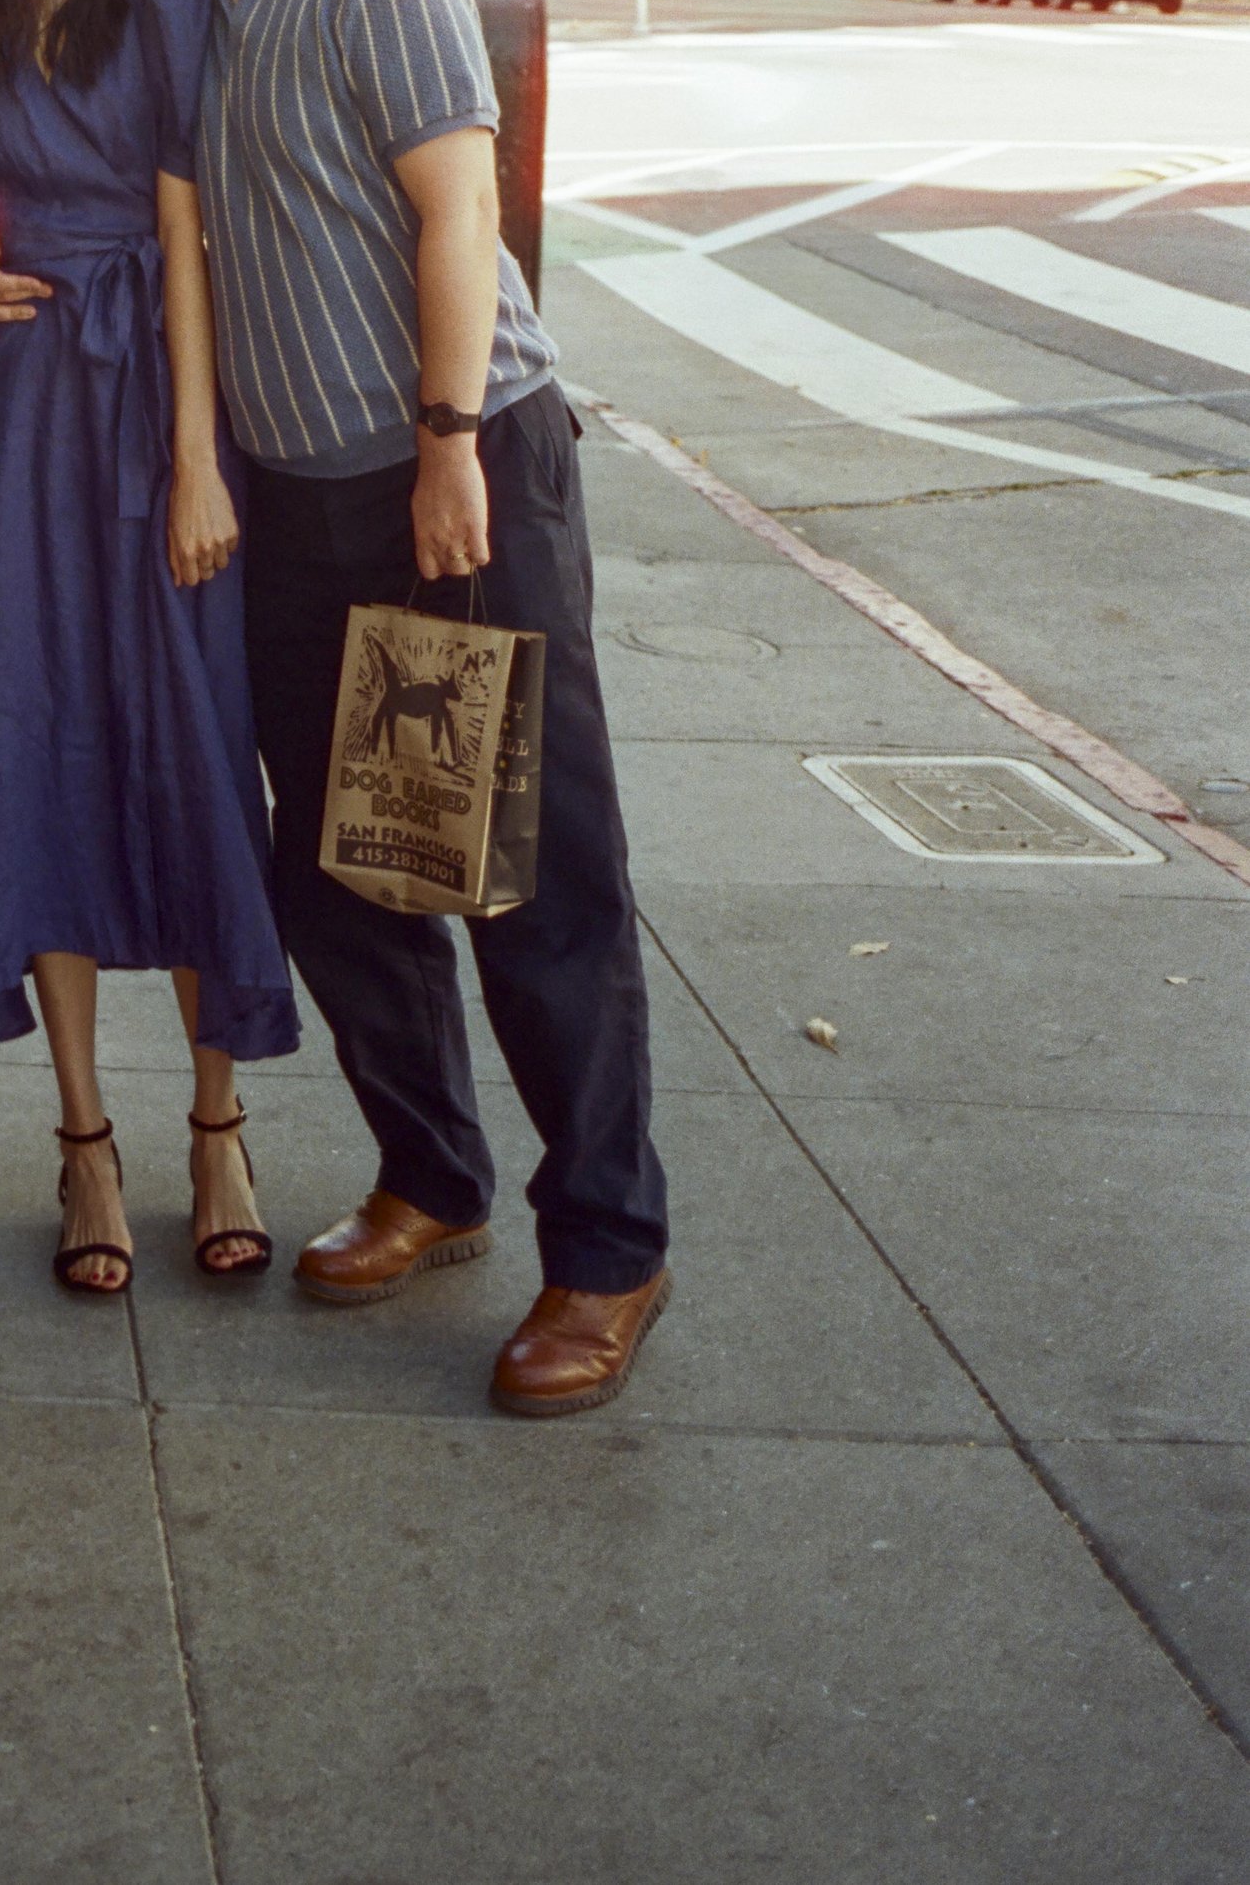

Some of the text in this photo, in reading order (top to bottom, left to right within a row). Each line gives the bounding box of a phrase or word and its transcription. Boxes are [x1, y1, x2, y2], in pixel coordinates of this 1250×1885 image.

[340, 767, 472, 815] DOG EARED
[371, 794, 441, 832] BOOKS
[337, 822, 467, 865] SAN FRANCISCO
